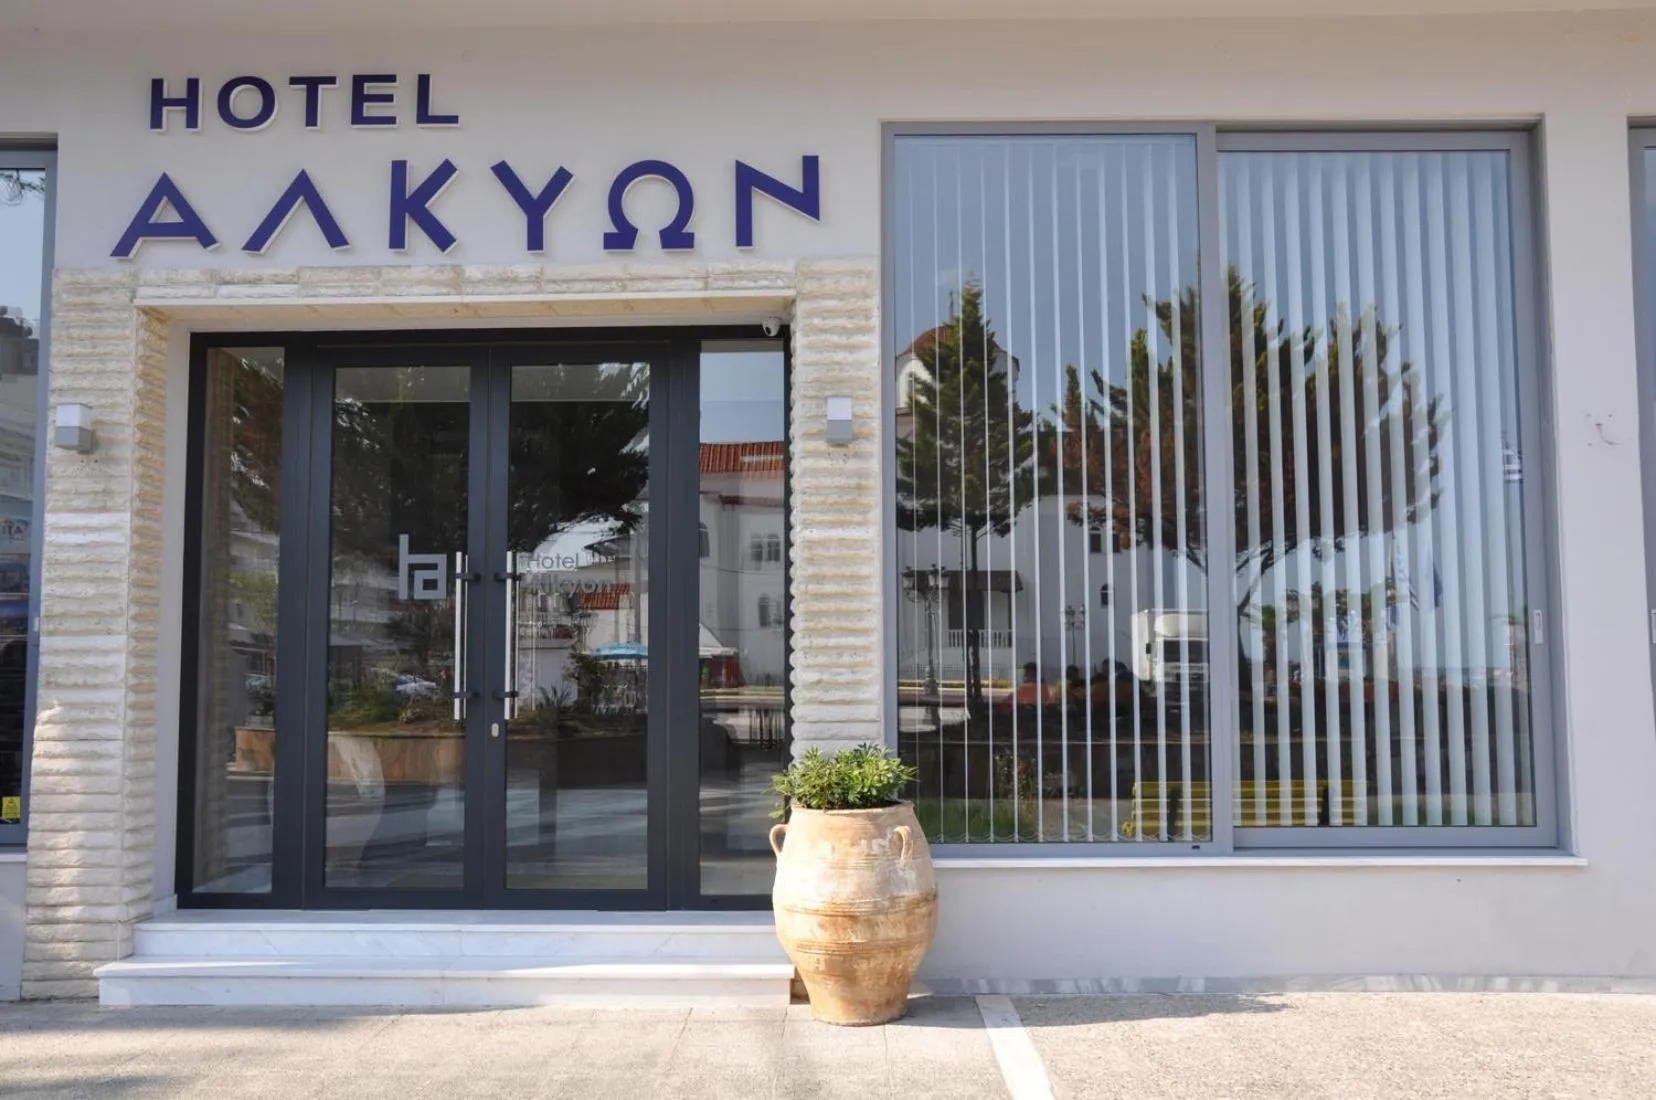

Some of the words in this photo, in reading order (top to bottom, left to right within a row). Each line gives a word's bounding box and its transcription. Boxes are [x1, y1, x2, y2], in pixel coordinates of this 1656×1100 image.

[150, 74, 459, 132] HOTEL
[111, 156, 821, 258] ΑΛΚΥΩΝ
[527, 552, 580, 570] Hotel
